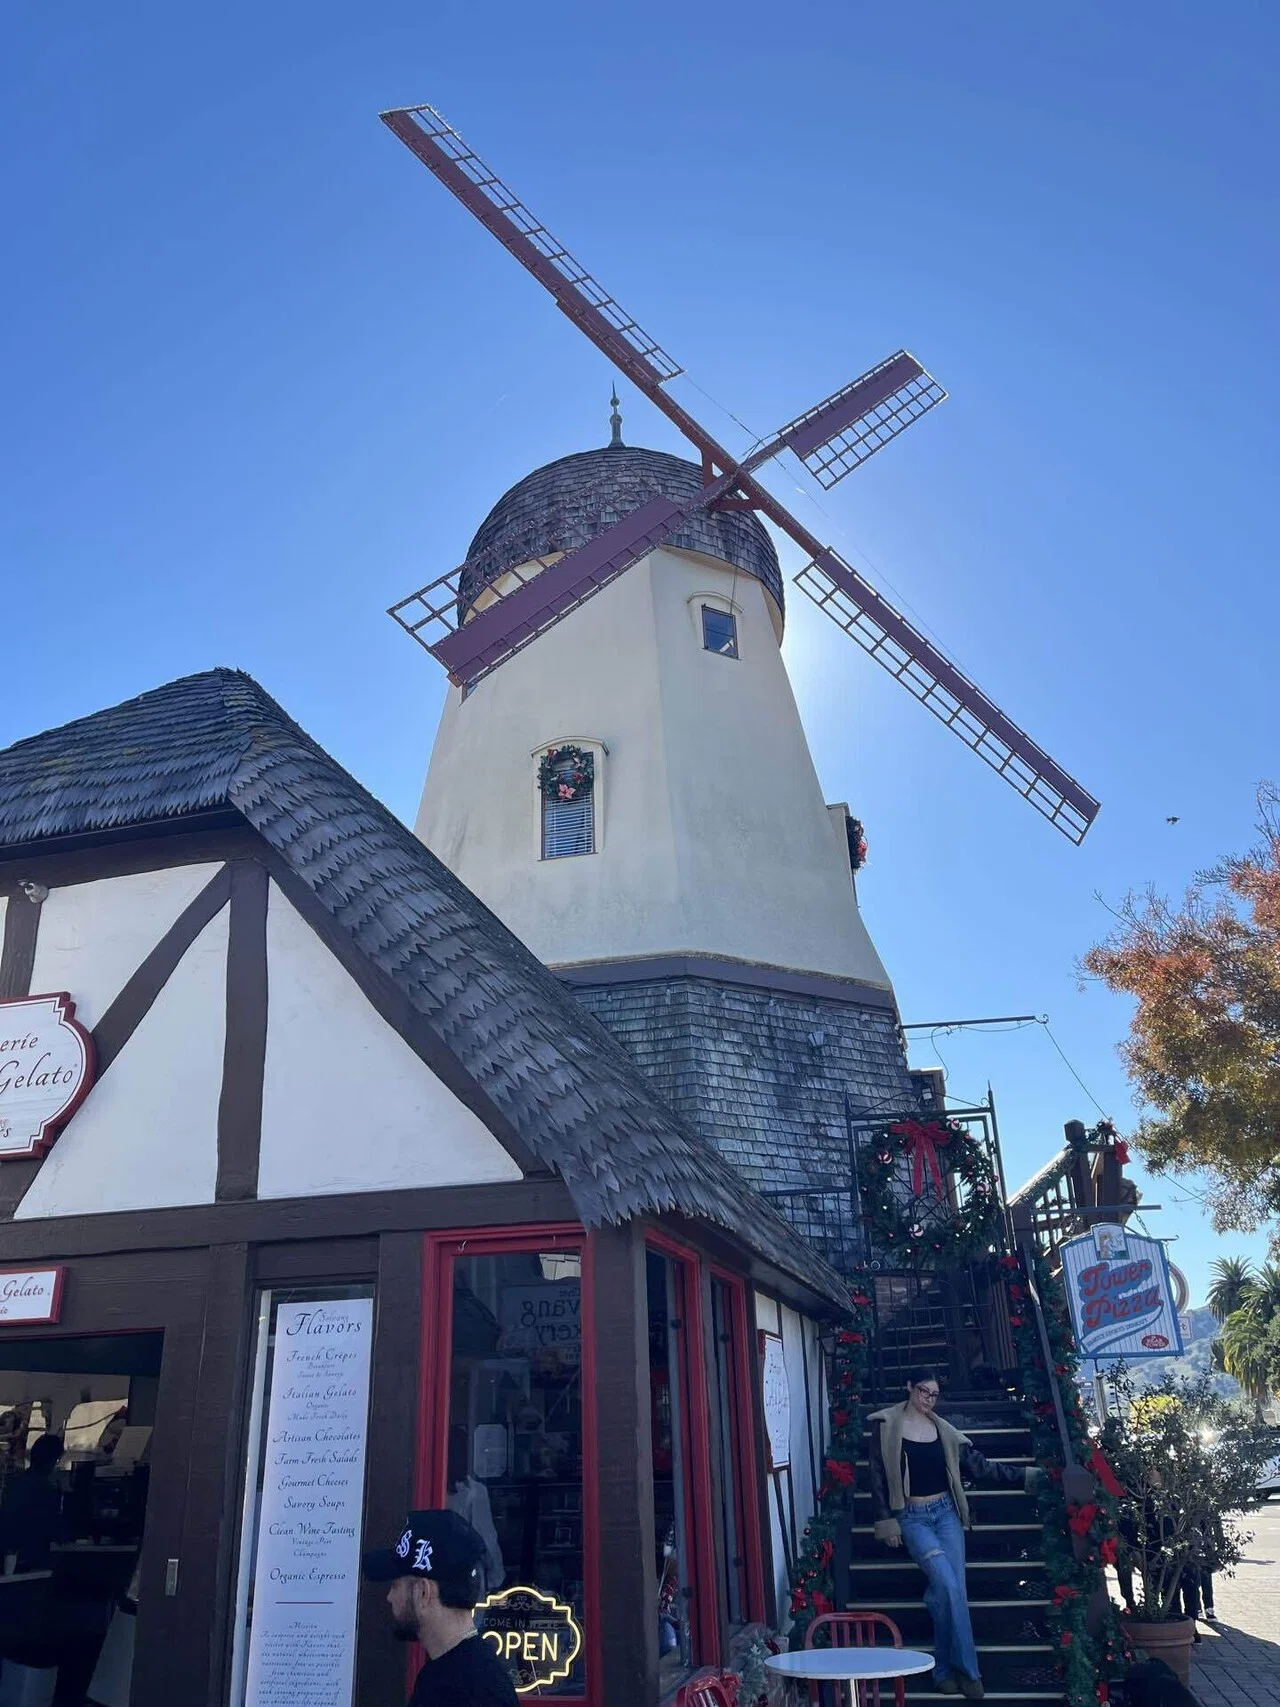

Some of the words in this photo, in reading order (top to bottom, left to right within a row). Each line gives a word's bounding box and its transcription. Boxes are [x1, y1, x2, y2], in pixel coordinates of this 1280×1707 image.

[0, 1052, 73, 1095] Gelato
[1083, 1261, 1151, 1296] Tower
[0, 1276, 44, 1303] Gelato
[1086, 1286, 1164, 1328] Pizza
[286, 1309, 362, 1336] Flavors
[287, 1347, 324, 1362] French
[283, 1385, 320, 1399] Italian
[323, 1383, 357, 1401] Gelato
[273, 1430, 311, 1443] Artisan
[315, 1427, 360, 1441] Chocolates
[274, 1452, 299, 1465] Farm
[301, 1449, 330, 1464] Fresh
[329, 1448, 359, 1463] Salads
[278, 1475, 315, 1490] Gourmet
[317, 1471, 348, 1486] Cheeses
[284, 1496, 315, 1512] Savory
[318, 1495, 345, 1511] Soups
[269, 1521, 294, 1535] Clean
[297, 1522, 320, 1534] Wine
[322, 1521, 355, 1538] Tasting
[412, 1539, 434, 1572] K
[270, 1568, 306, 1584] Organic
[308, 1567, 346, 1584] Espresso
[483, 1618, 511, 1630] COME
[515, 1618, 527, 1630] IN
[482, 1630, 558, 1662] OPEN
